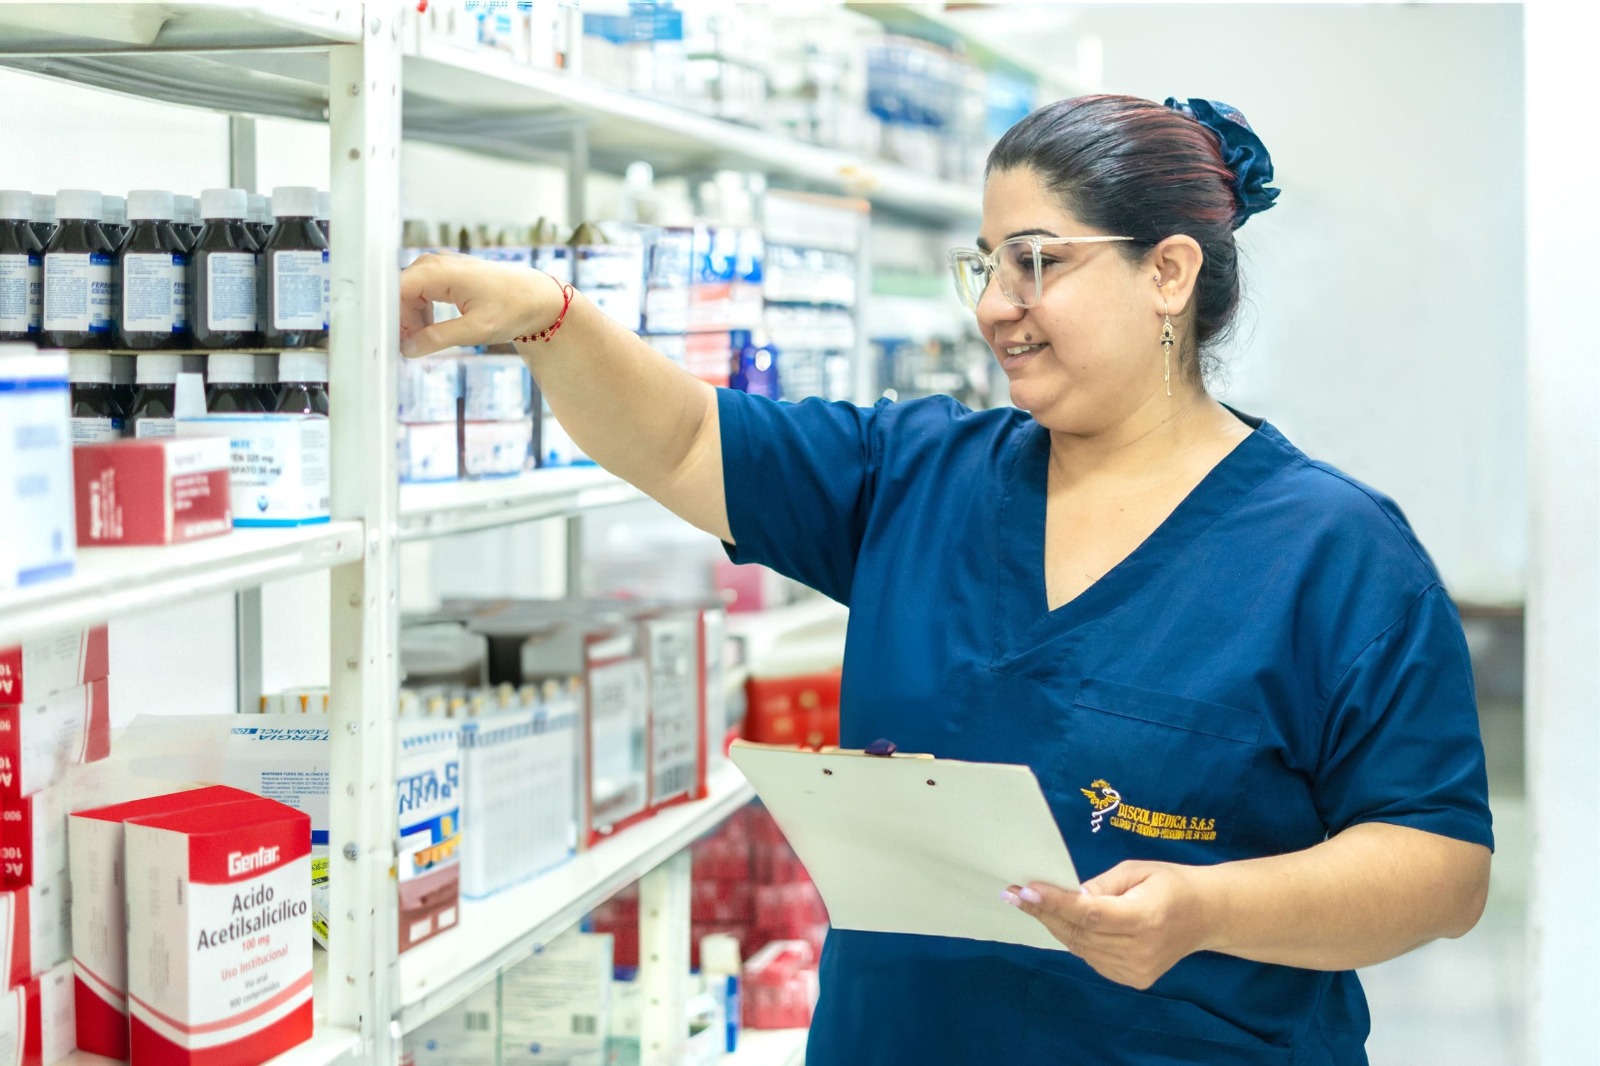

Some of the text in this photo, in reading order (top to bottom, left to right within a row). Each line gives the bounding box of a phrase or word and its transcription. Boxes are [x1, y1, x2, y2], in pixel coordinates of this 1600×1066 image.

[270, 468, 282, 476] mg
[1117, 803, 1150, 824] DISCOL
[1151, 811, 1187, 829] MEDICA
[228, 846, 279, 877] Genfar
[232, 883, 274, 916] Acido
[242, 934, 270, 951] 100 mg
[221, 944, 289, 981] Uso Institucional
